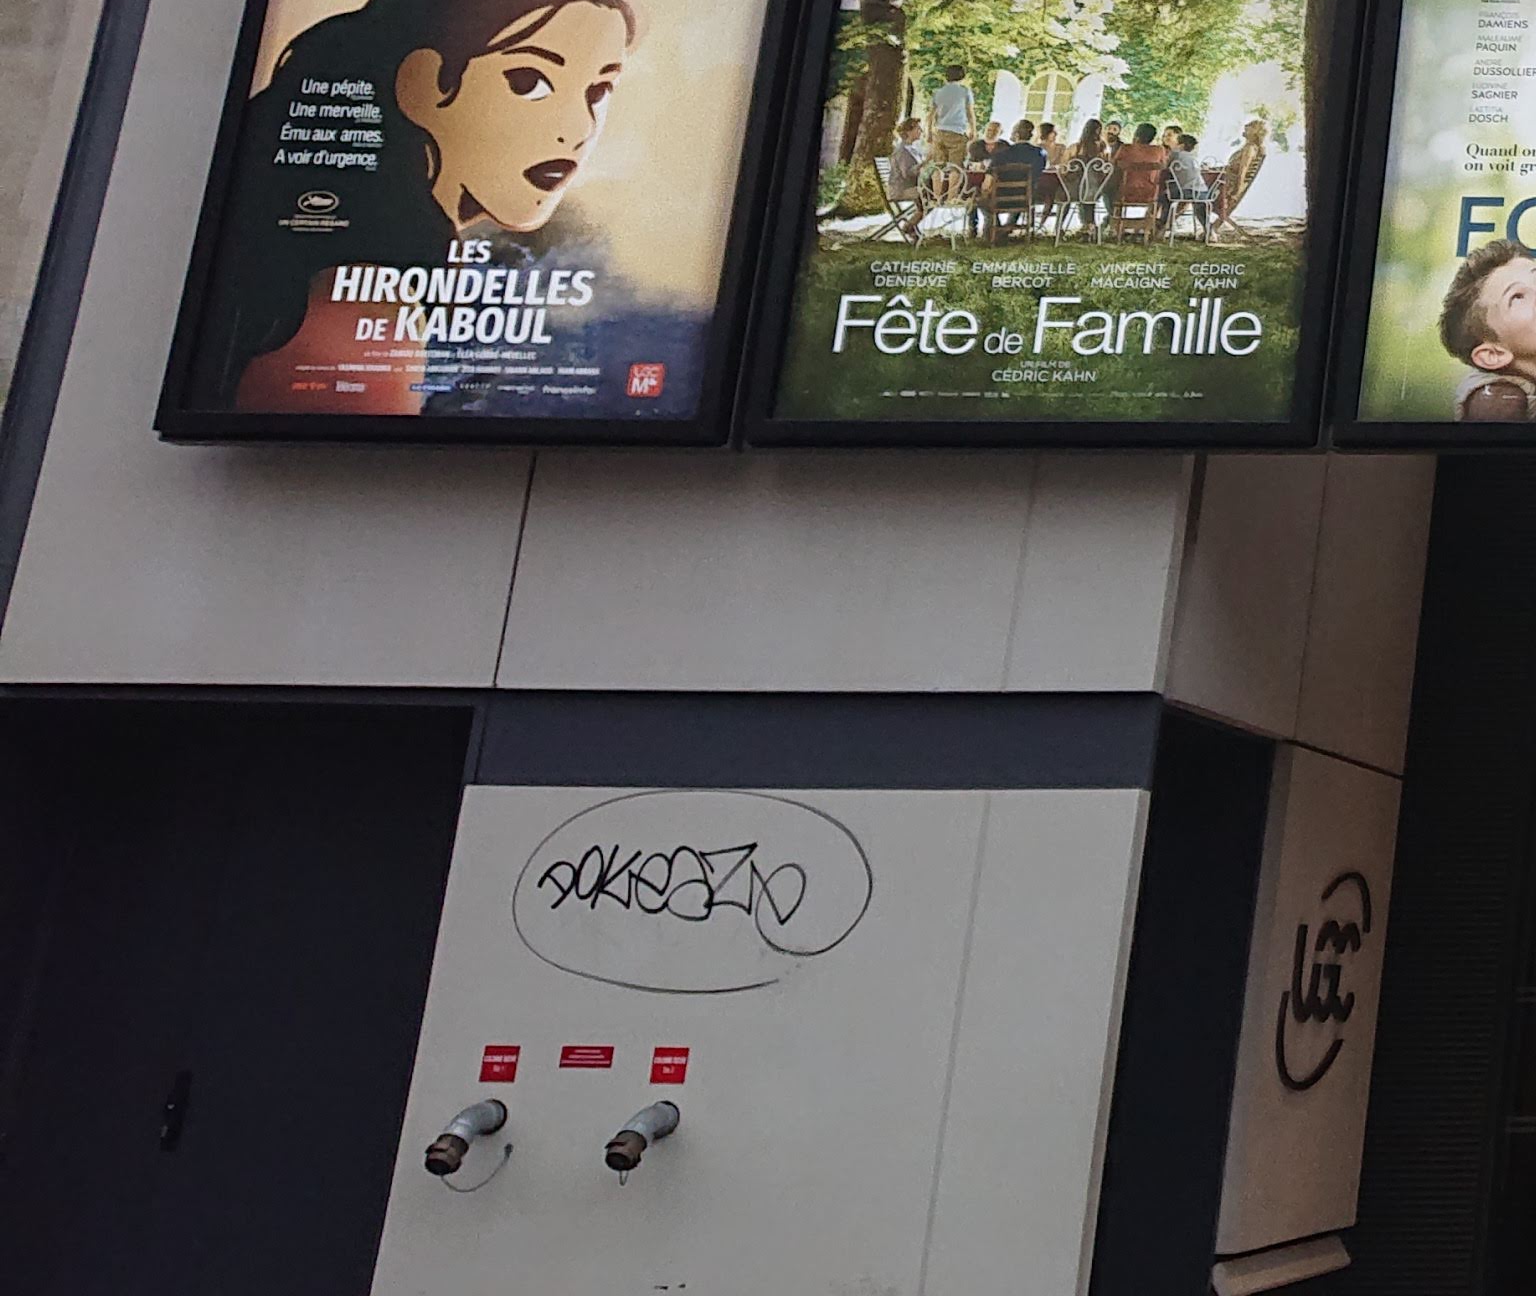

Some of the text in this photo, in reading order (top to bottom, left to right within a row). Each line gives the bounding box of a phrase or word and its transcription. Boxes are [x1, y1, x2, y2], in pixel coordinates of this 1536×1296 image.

[1477, 19, 1529, 30] DAMIENS
[1475, 42, 1517, 53] PAQUIN
[301, 78, 375, 98] Une pépite.
[1471, 89, 1519, 100] SAGNIER
[289, 101, 382, 120] Une merveille.
[1468, 113, 1509, 124] DOSCH
[1465, 143, 1518, 161] Quand
[1464, 161, 1485, 173] on
[1488, 159, 1516, 173] voit
[447, 238, 492, 265] LES
[870, 260, 1245, 276] CATHERINE EMMANUELLE VINCENT CÉDRIC
[330, 264, 596, 306] HIRONDELLES
[874, 275, 1238, 290] DENEUVE BERCOT MACAIGNE KAHN
[355, 306, 554, 345] DE KABOUL
[831, 294, 1264, 356] Fête de Famille
